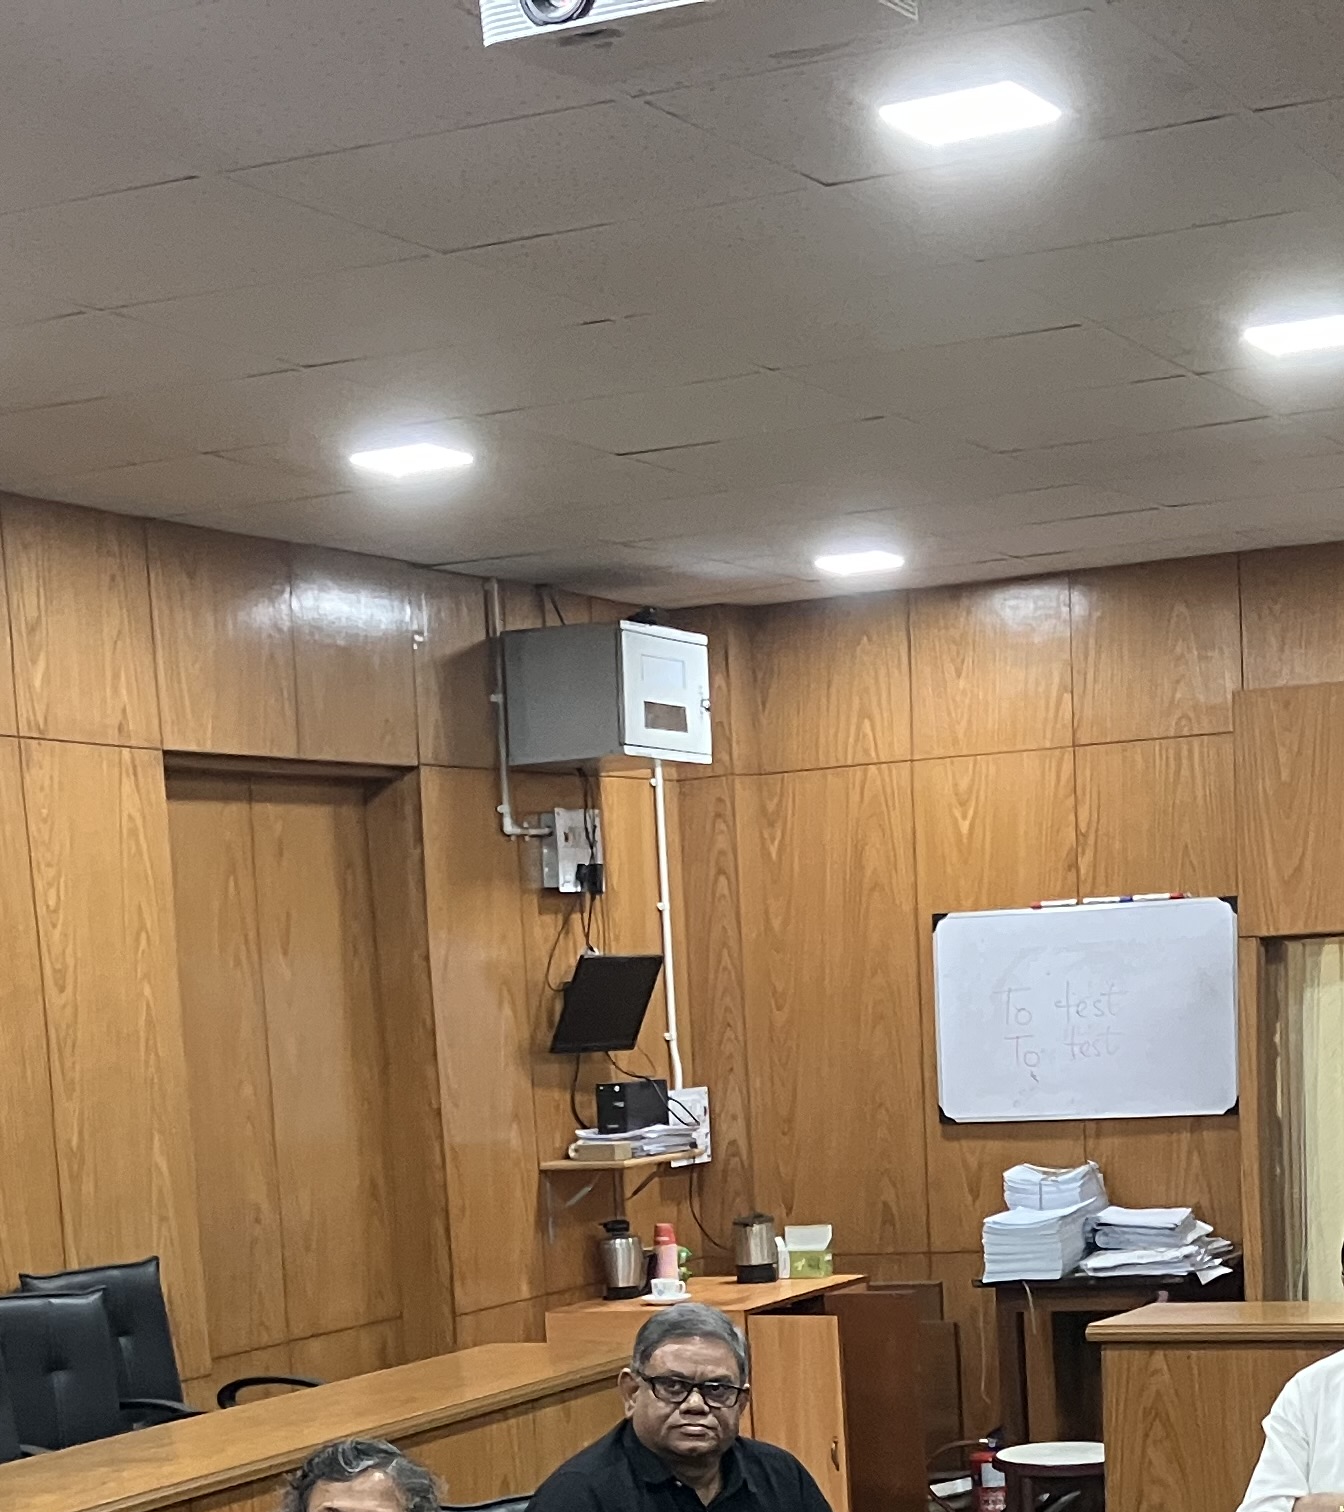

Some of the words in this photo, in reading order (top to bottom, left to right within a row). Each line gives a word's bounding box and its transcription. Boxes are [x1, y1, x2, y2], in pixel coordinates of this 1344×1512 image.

[992, 987, 1032, 1025] To
[1054, 980, 1129, 1025] test
[1004, 1034, 1040, 1067] To
